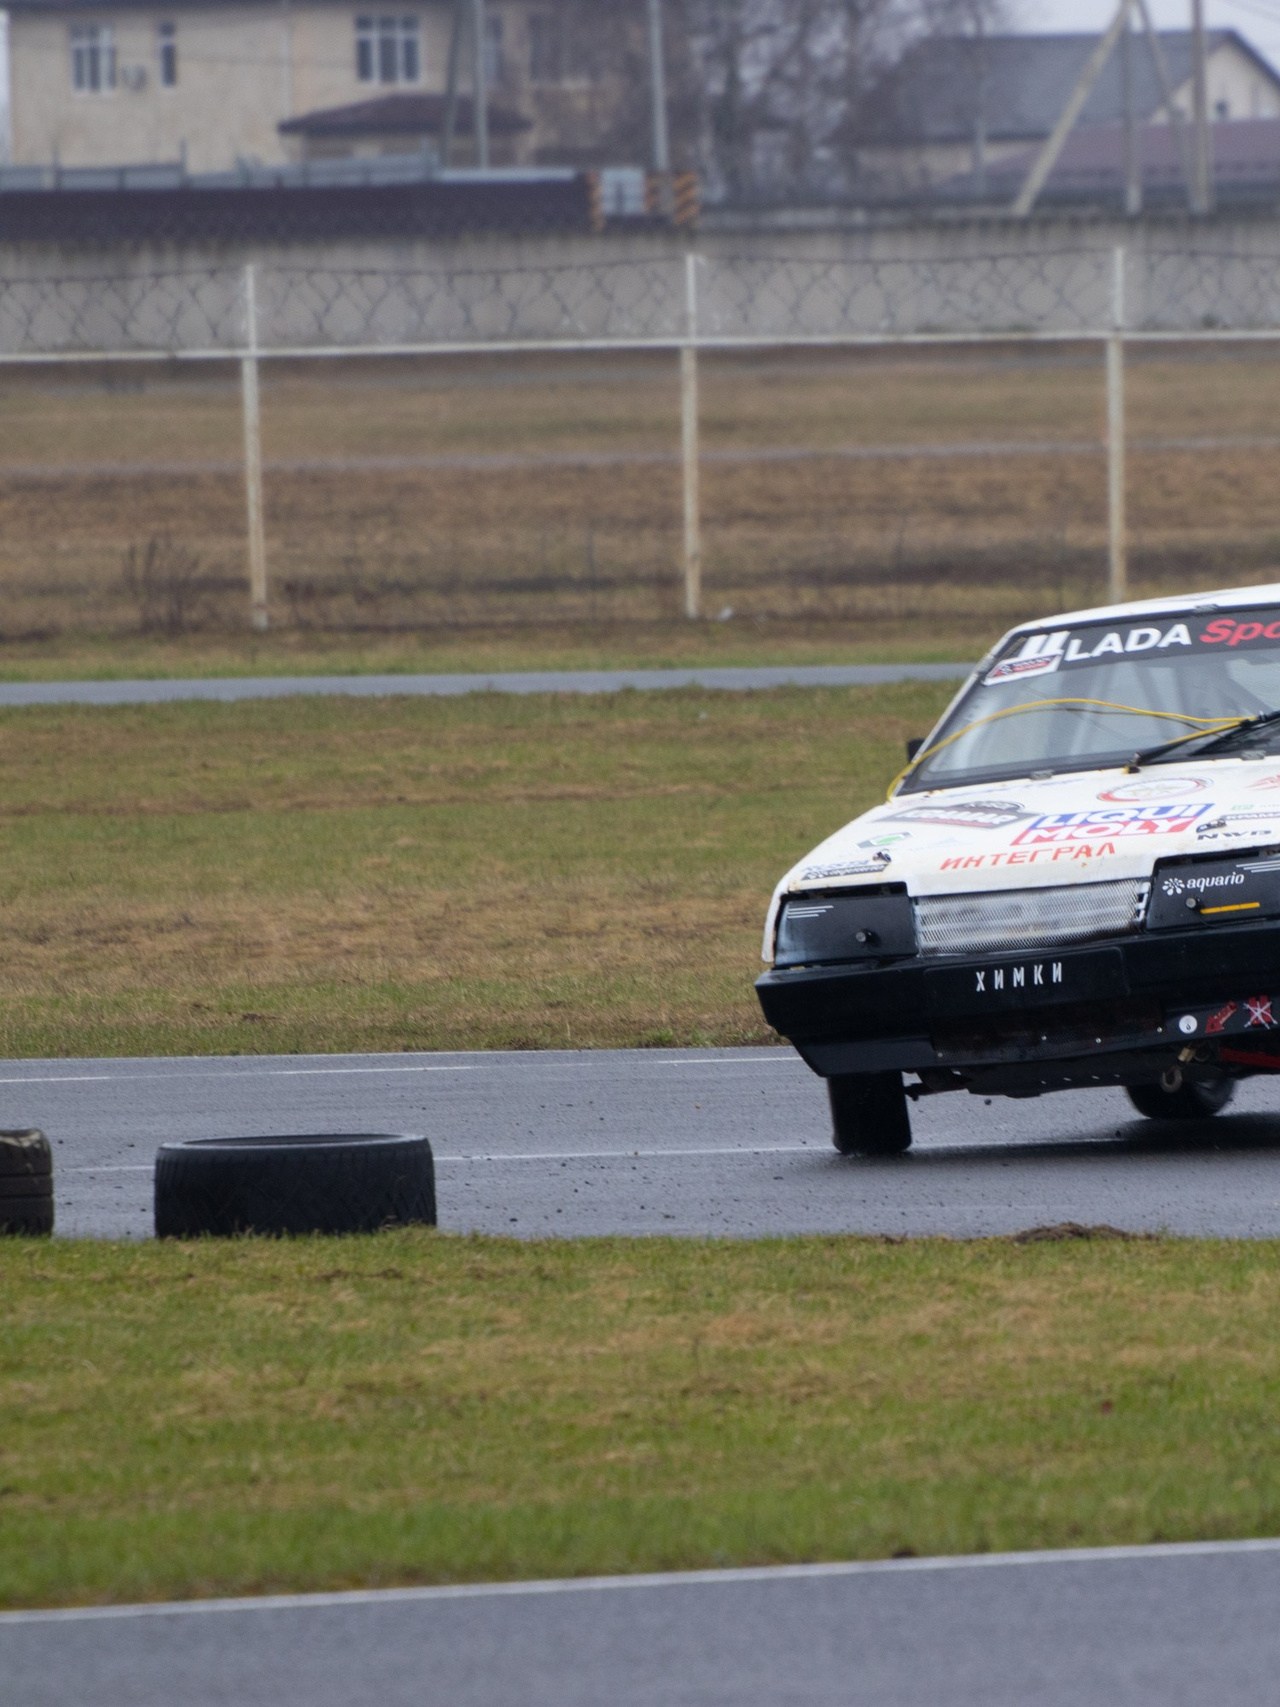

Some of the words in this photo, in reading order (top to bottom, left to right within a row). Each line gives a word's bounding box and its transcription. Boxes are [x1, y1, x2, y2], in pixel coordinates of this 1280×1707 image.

[1064, 623, 1192, 662] LADA
[1019, 817, 1182, 844] MOLY
[1040, 805, 1202, 828] LIQUI
[939, 842, 1117, 871] ИНТЕГРАЛ
[1186, 871, 1245, 893] aquario
[975, 962, 1063, 993] ХИМКИ
